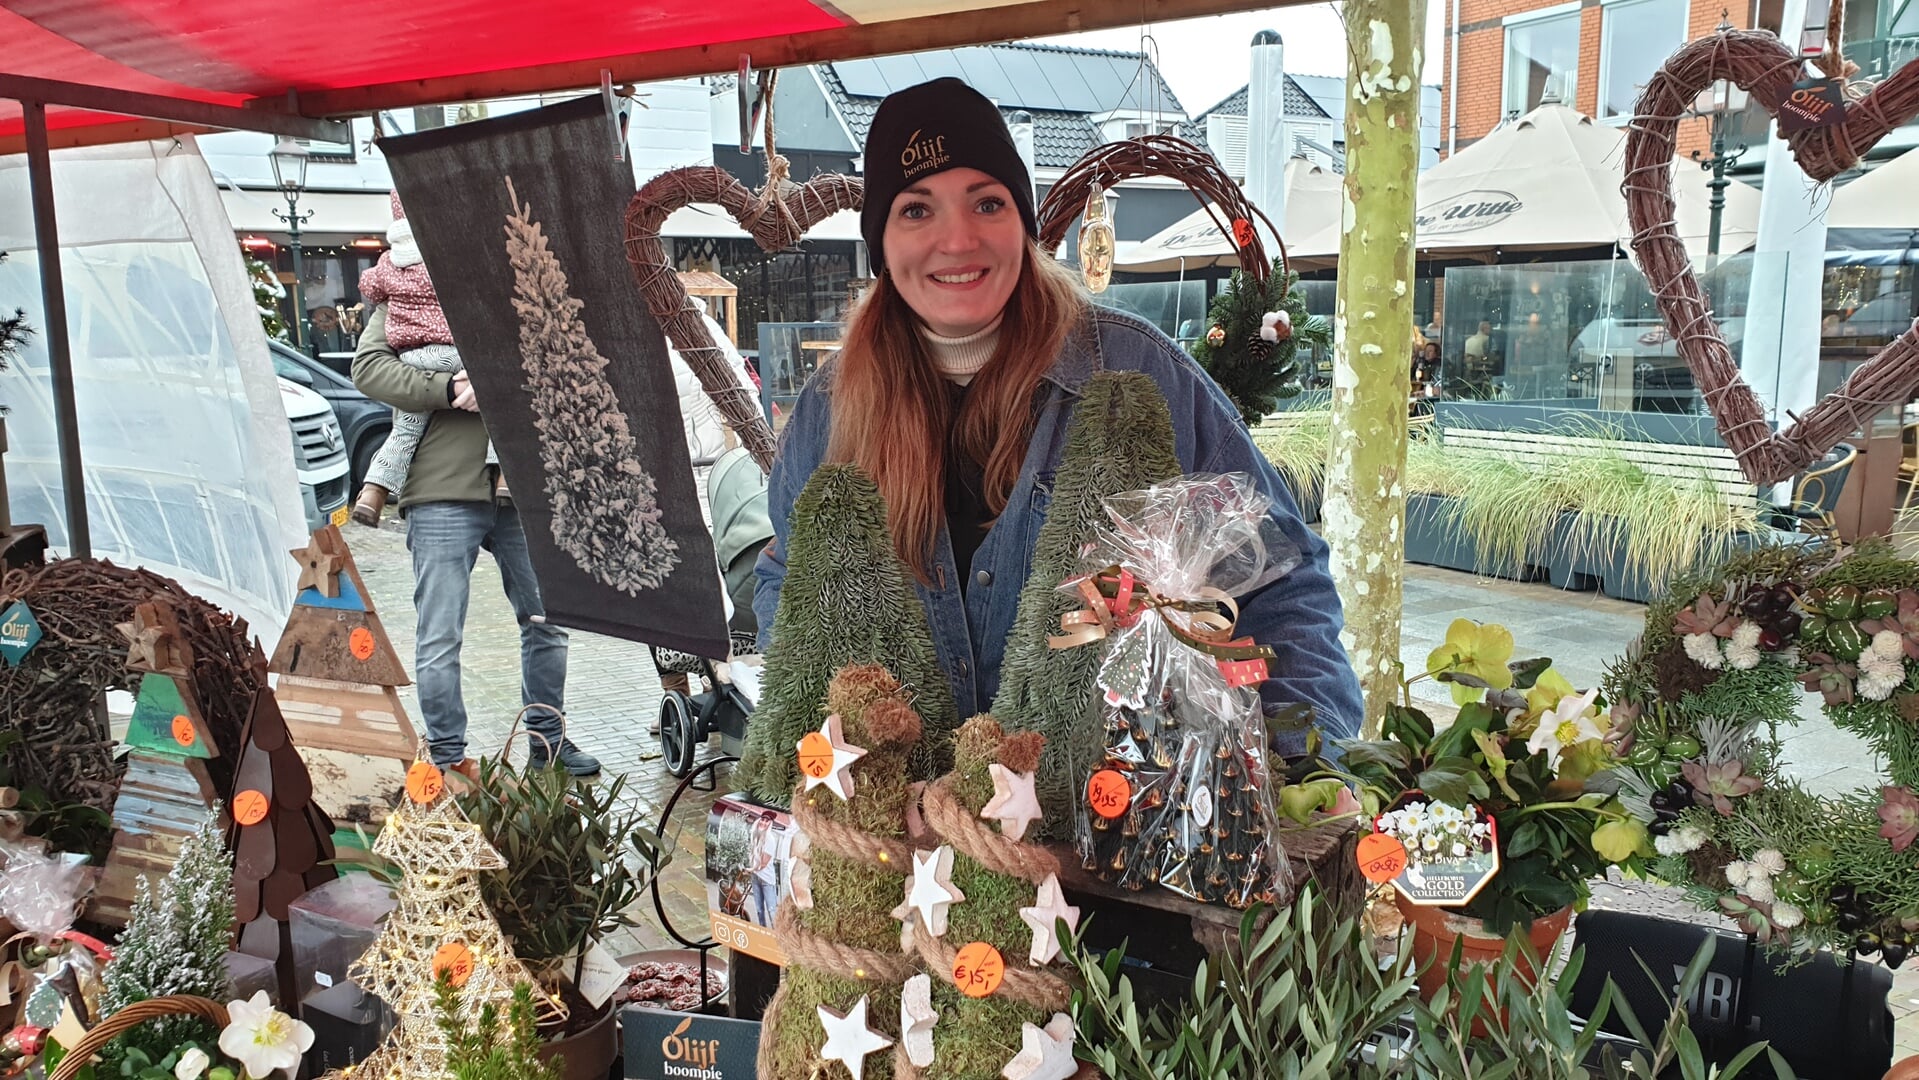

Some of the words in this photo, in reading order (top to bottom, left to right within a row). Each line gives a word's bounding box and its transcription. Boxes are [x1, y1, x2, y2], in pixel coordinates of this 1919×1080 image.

[1791, 87, 1834, 115] Olijf
[901, 133, 945, 166] Olijf
[1442, 200, 1523, 220] Witte
[1, 619, 31, 640] Olijf
[1426, 881, 1465, 890] GOLD
[662, 1030, 720, 1070] Olijf
